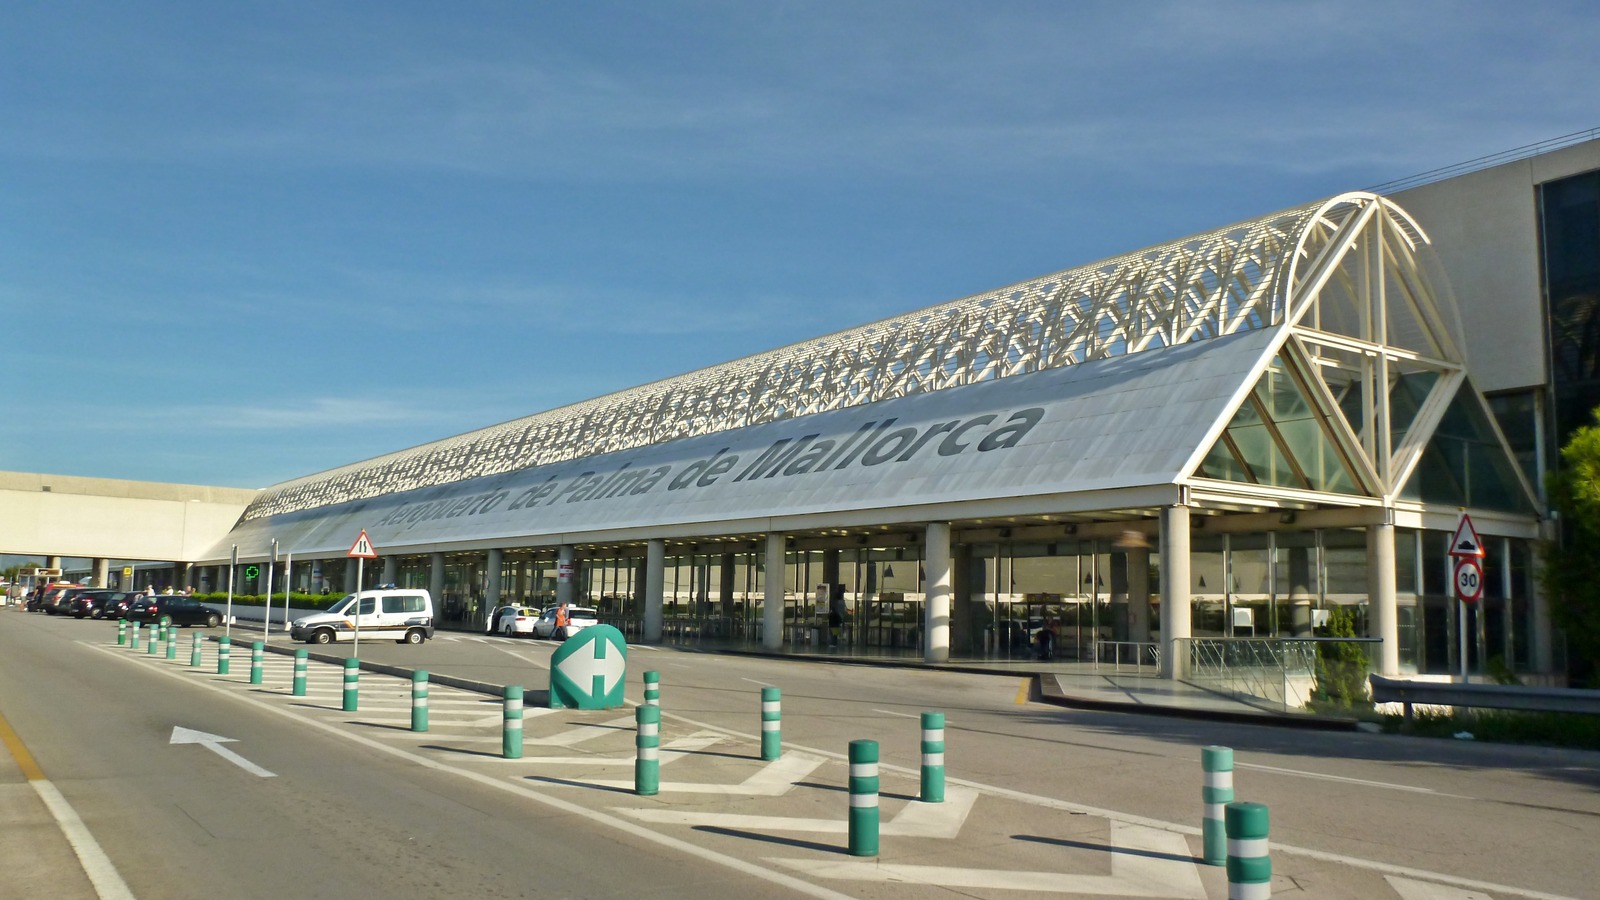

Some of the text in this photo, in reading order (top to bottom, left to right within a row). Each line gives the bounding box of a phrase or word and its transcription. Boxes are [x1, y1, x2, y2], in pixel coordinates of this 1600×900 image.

[372, 407, 1045, 530] Aeropuerto de Palma de Mallorca
[1460, 572, 1477, 588] 30
